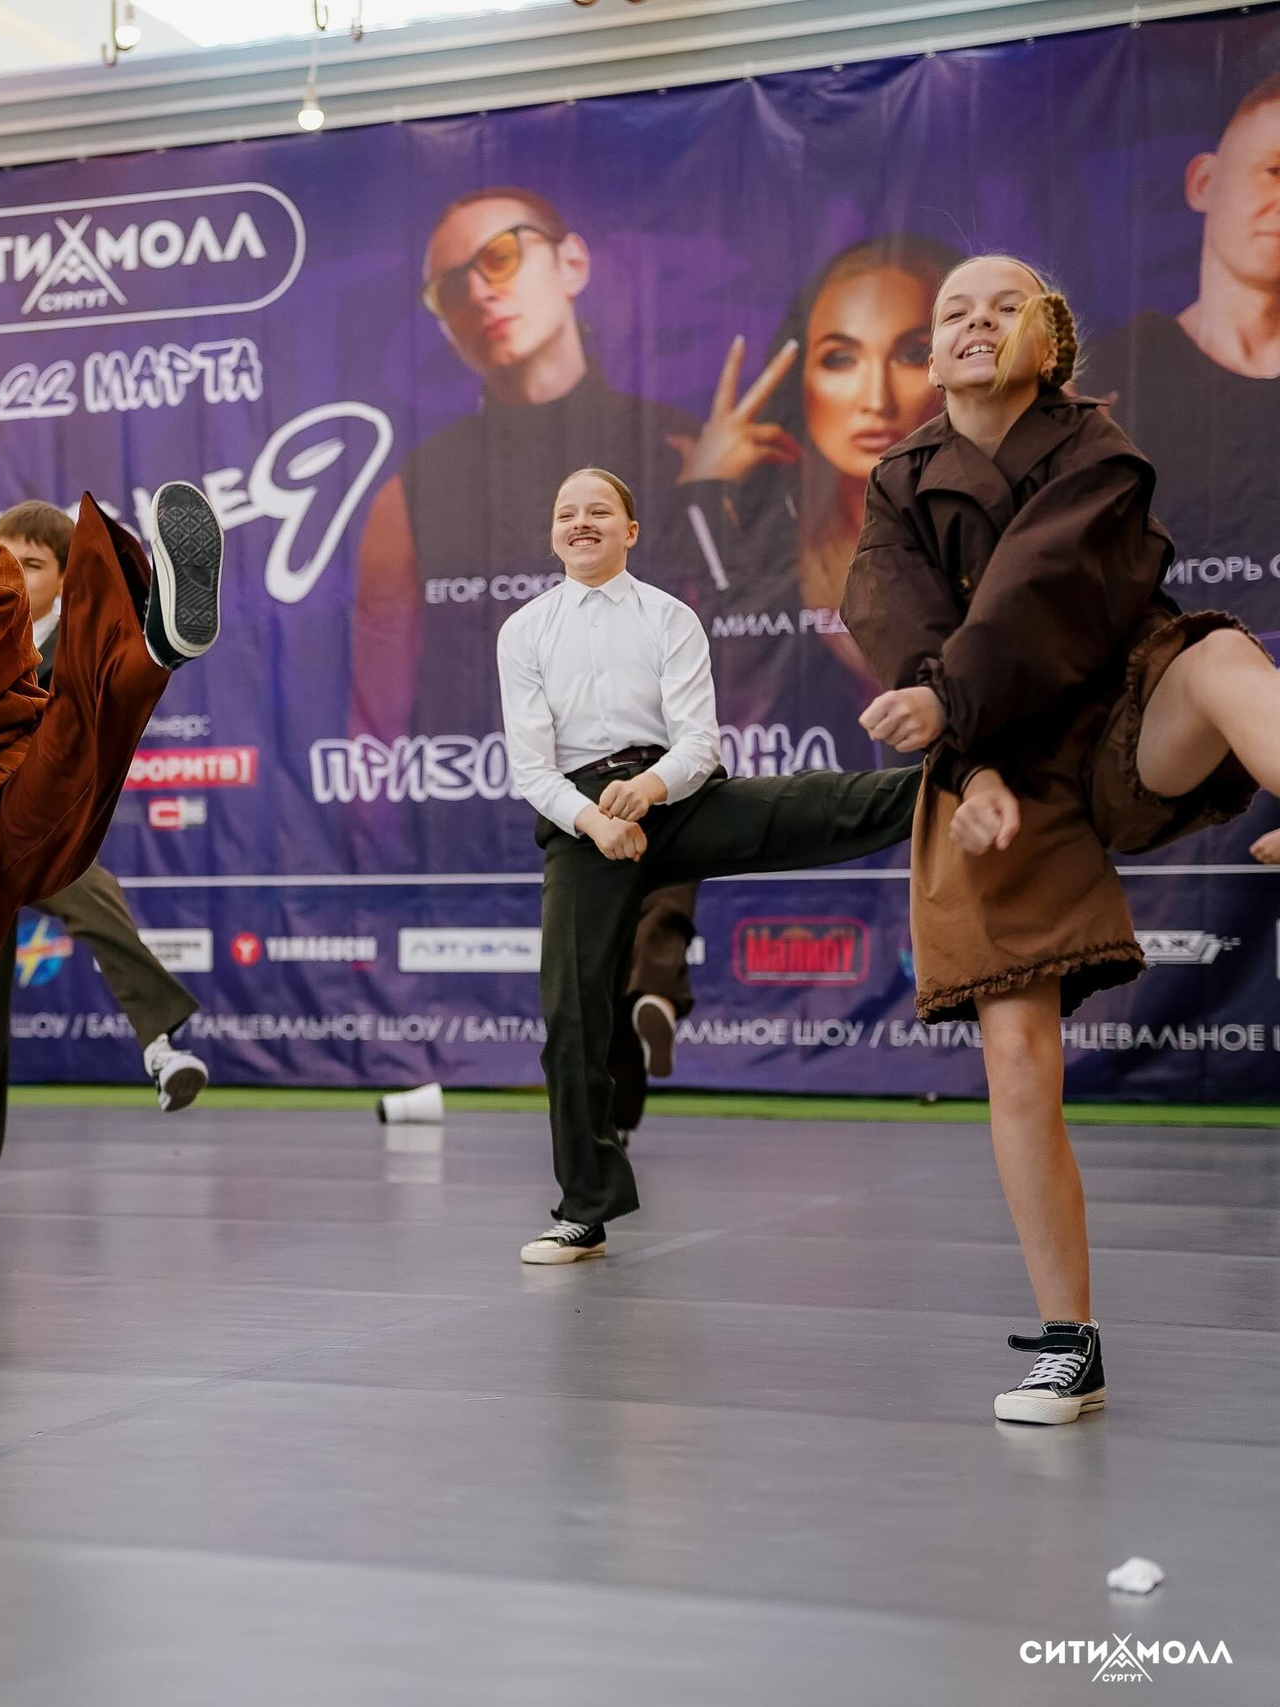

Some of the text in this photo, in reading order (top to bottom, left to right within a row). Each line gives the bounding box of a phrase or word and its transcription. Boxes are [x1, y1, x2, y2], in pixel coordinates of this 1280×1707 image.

[94, 211, 267, 271] МОЛЛ
[83, 337, 263, 413] МАРТА
[1163, 556, 1263, 585] ИГОРЬ
[425, 572, 566, 604] ЕГОР СОКО
[799, 607, 850, 635] РЕД
[309, 734, 520, 804] ПРИЗО
[377, 1014, 441, 1042] ШОУ
[792, 1018, 863, 1047] ШОУ
[1060, 1022, 1266, 1051] НЦЕВАЛЬНОЕ
